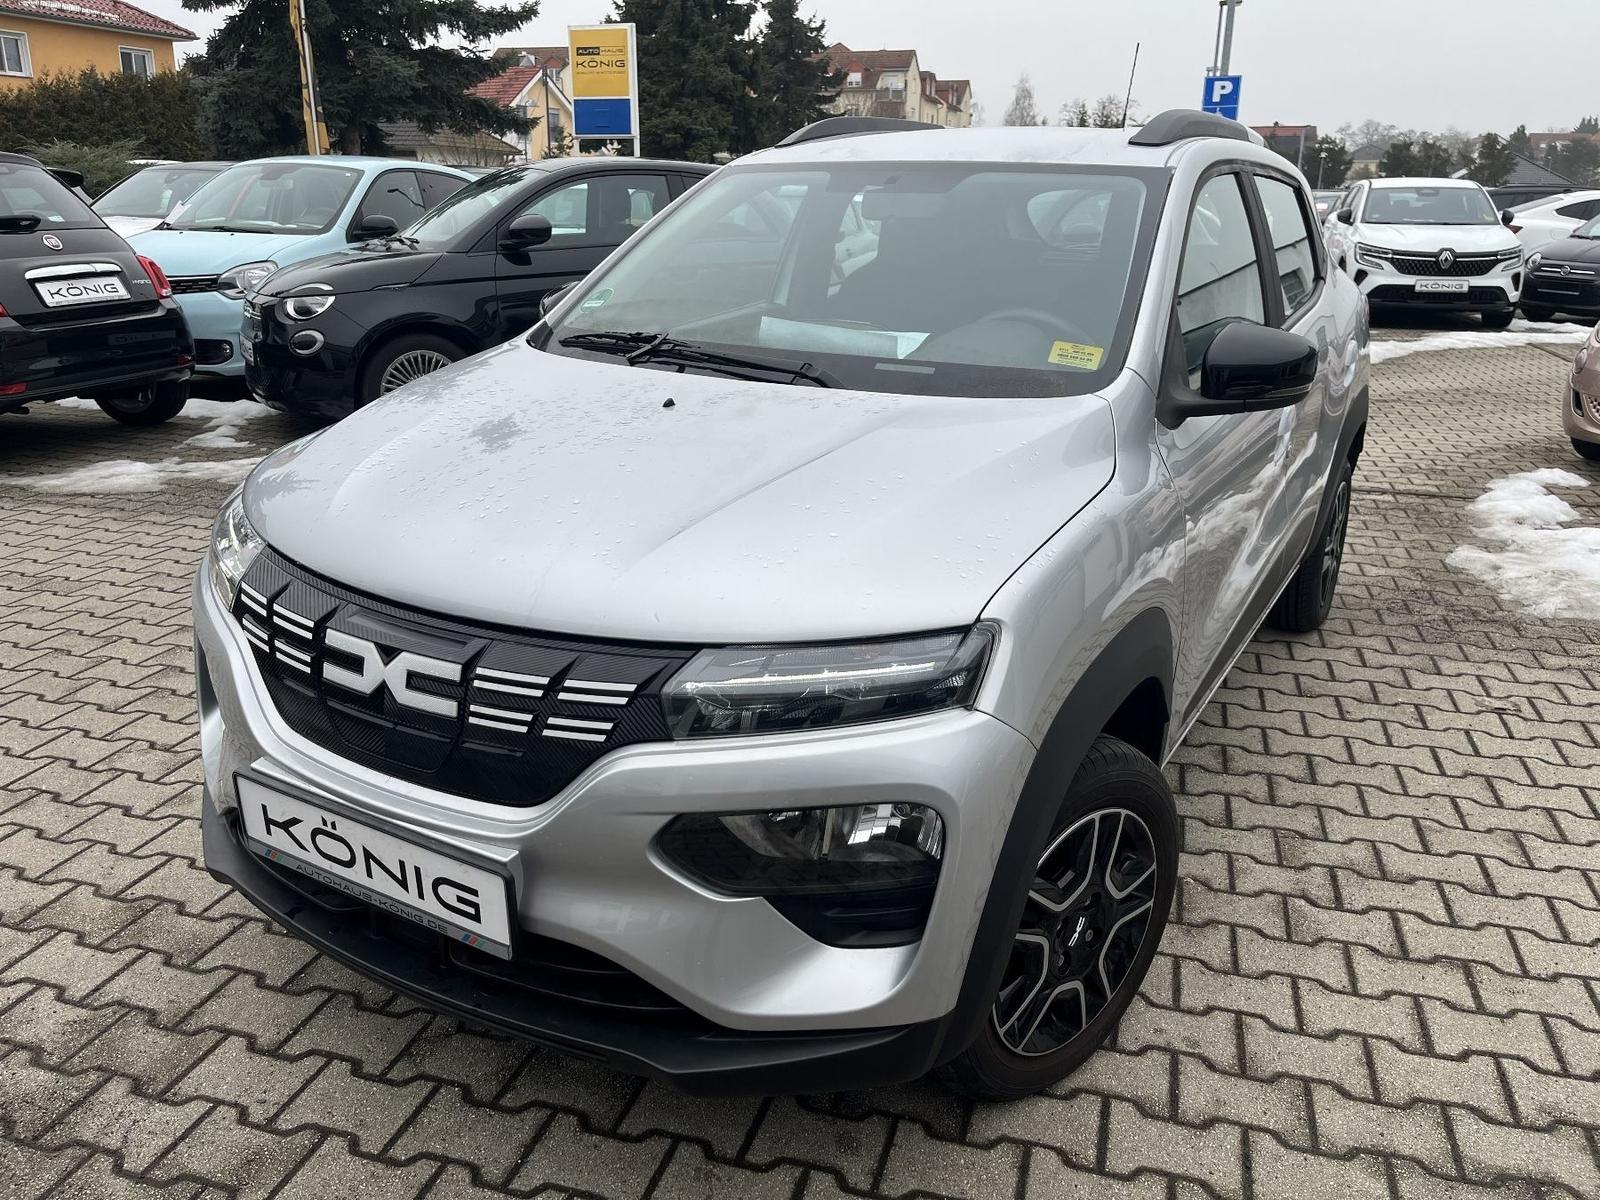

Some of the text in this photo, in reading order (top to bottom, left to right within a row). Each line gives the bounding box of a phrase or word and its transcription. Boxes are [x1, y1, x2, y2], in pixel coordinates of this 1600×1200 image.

[576, 58, 625, 68] KÖNIG
[1212, 80, 1234, 103] P
[47, 283, 119, 299] KÖNIG
[1419, 281, 1464, 290] KÖNIG
[261, 803, 482, 924] KÖNIG
